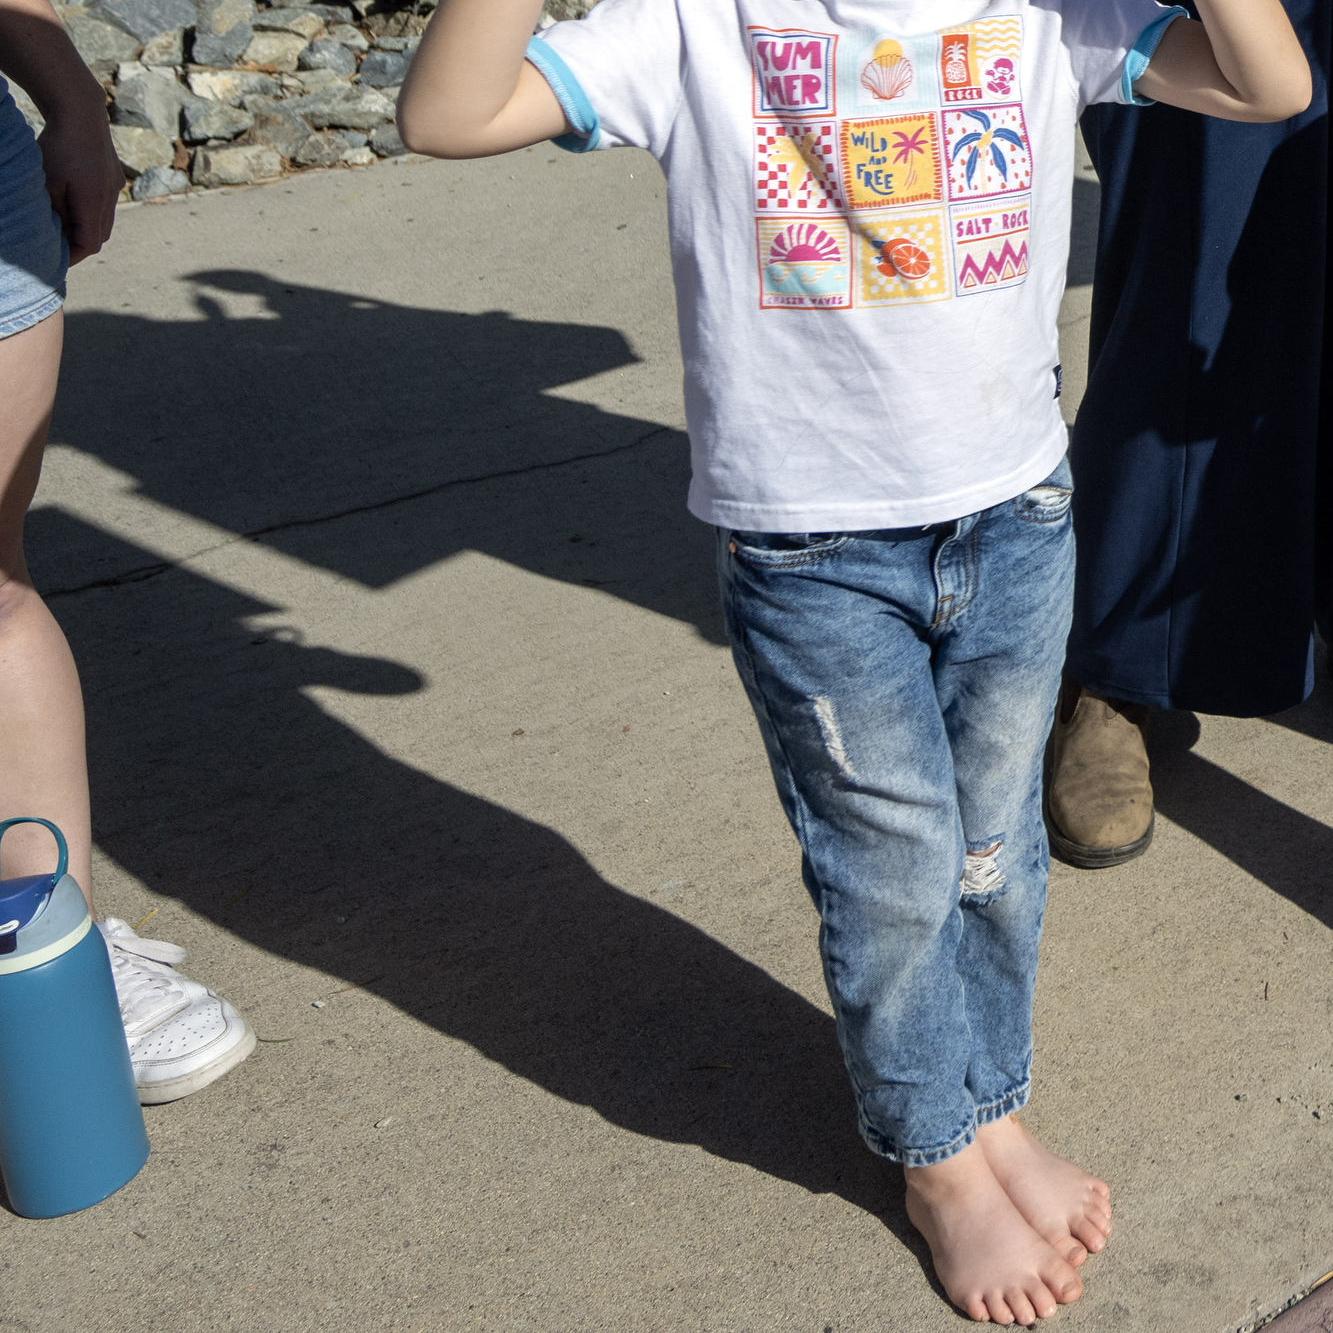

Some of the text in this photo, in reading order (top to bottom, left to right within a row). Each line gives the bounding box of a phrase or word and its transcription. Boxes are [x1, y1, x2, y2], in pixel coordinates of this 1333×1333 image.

[757, 41, 822, 71] SUM
[765, 74, 822, 105] MER
[856, 164, 894, 195] FREE
[956, 210, 1028, 237] SALT ROCK
